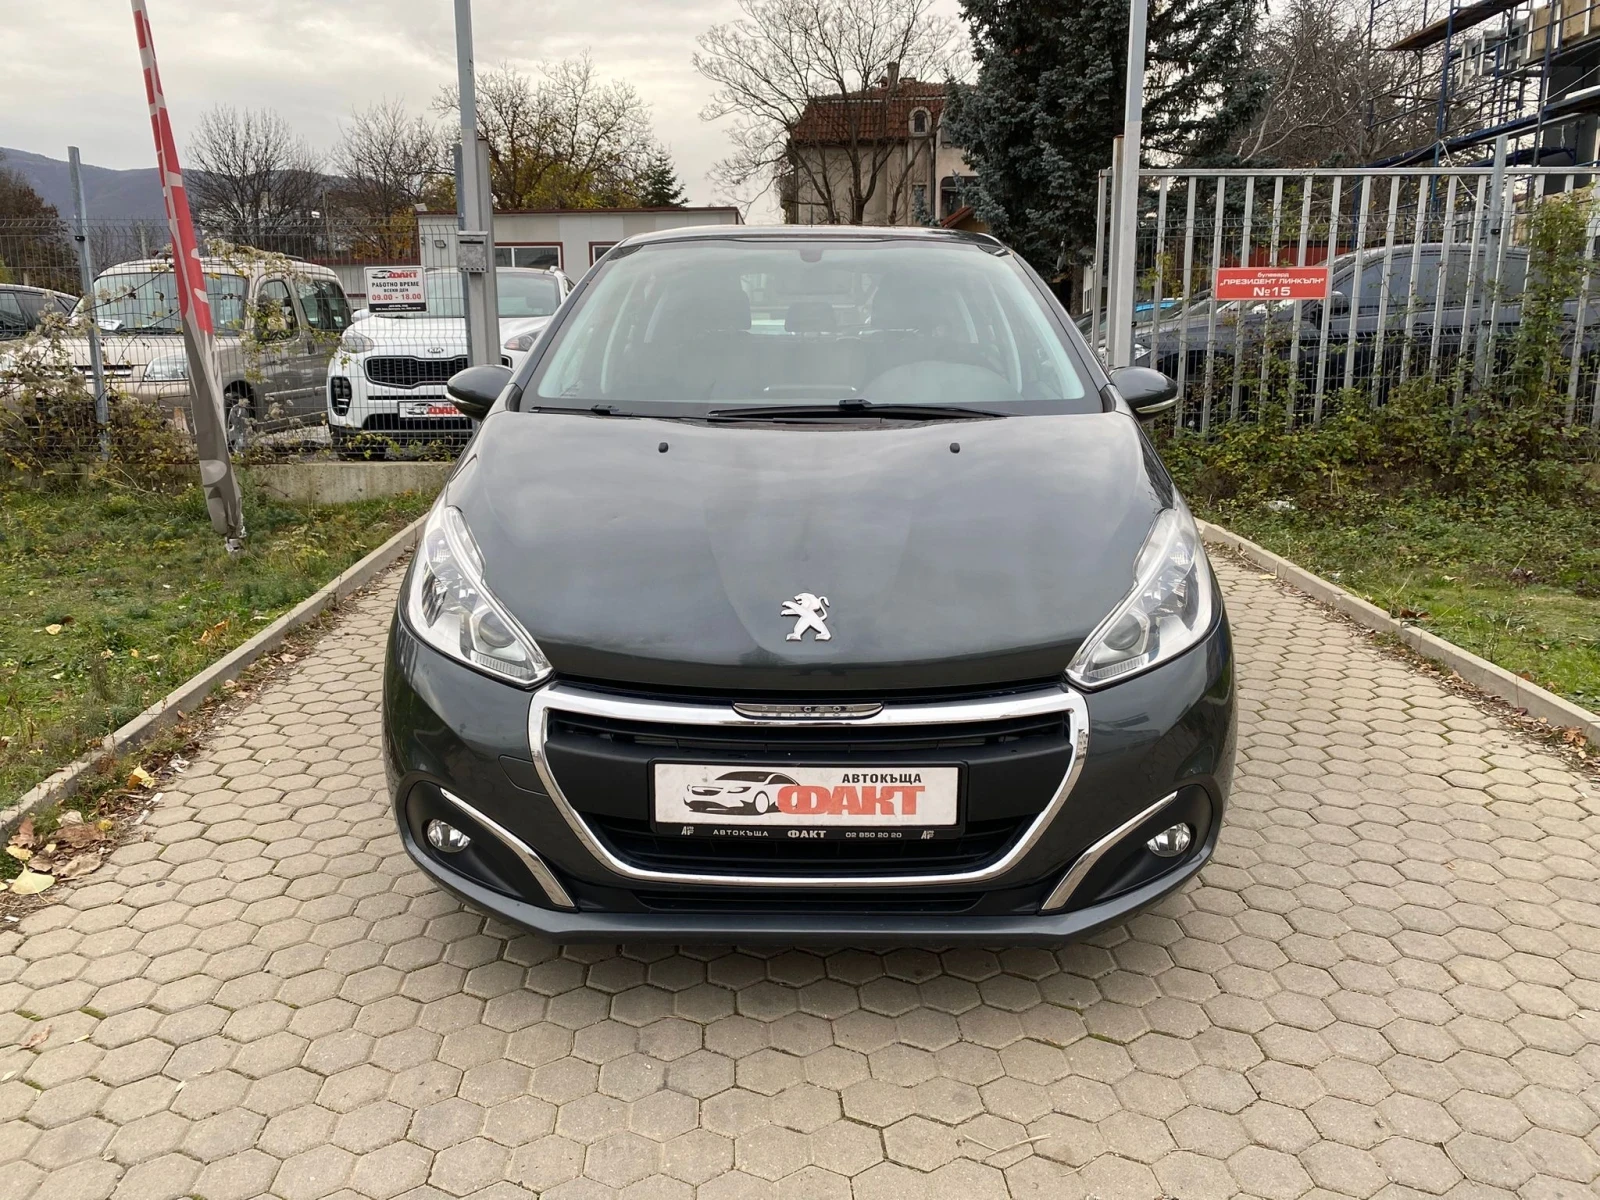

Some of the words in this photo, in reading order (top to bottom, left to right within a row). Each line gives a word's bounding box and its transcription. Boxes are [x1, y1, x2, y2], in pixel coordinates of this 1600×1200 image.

[428, 406, 463, 414] ФАК
[842, 773, 922, 785] АВТОКЪЩА
[777, 785, 925, 815] ФАКТ
[787, 830, 827, 838] ФАКТ
